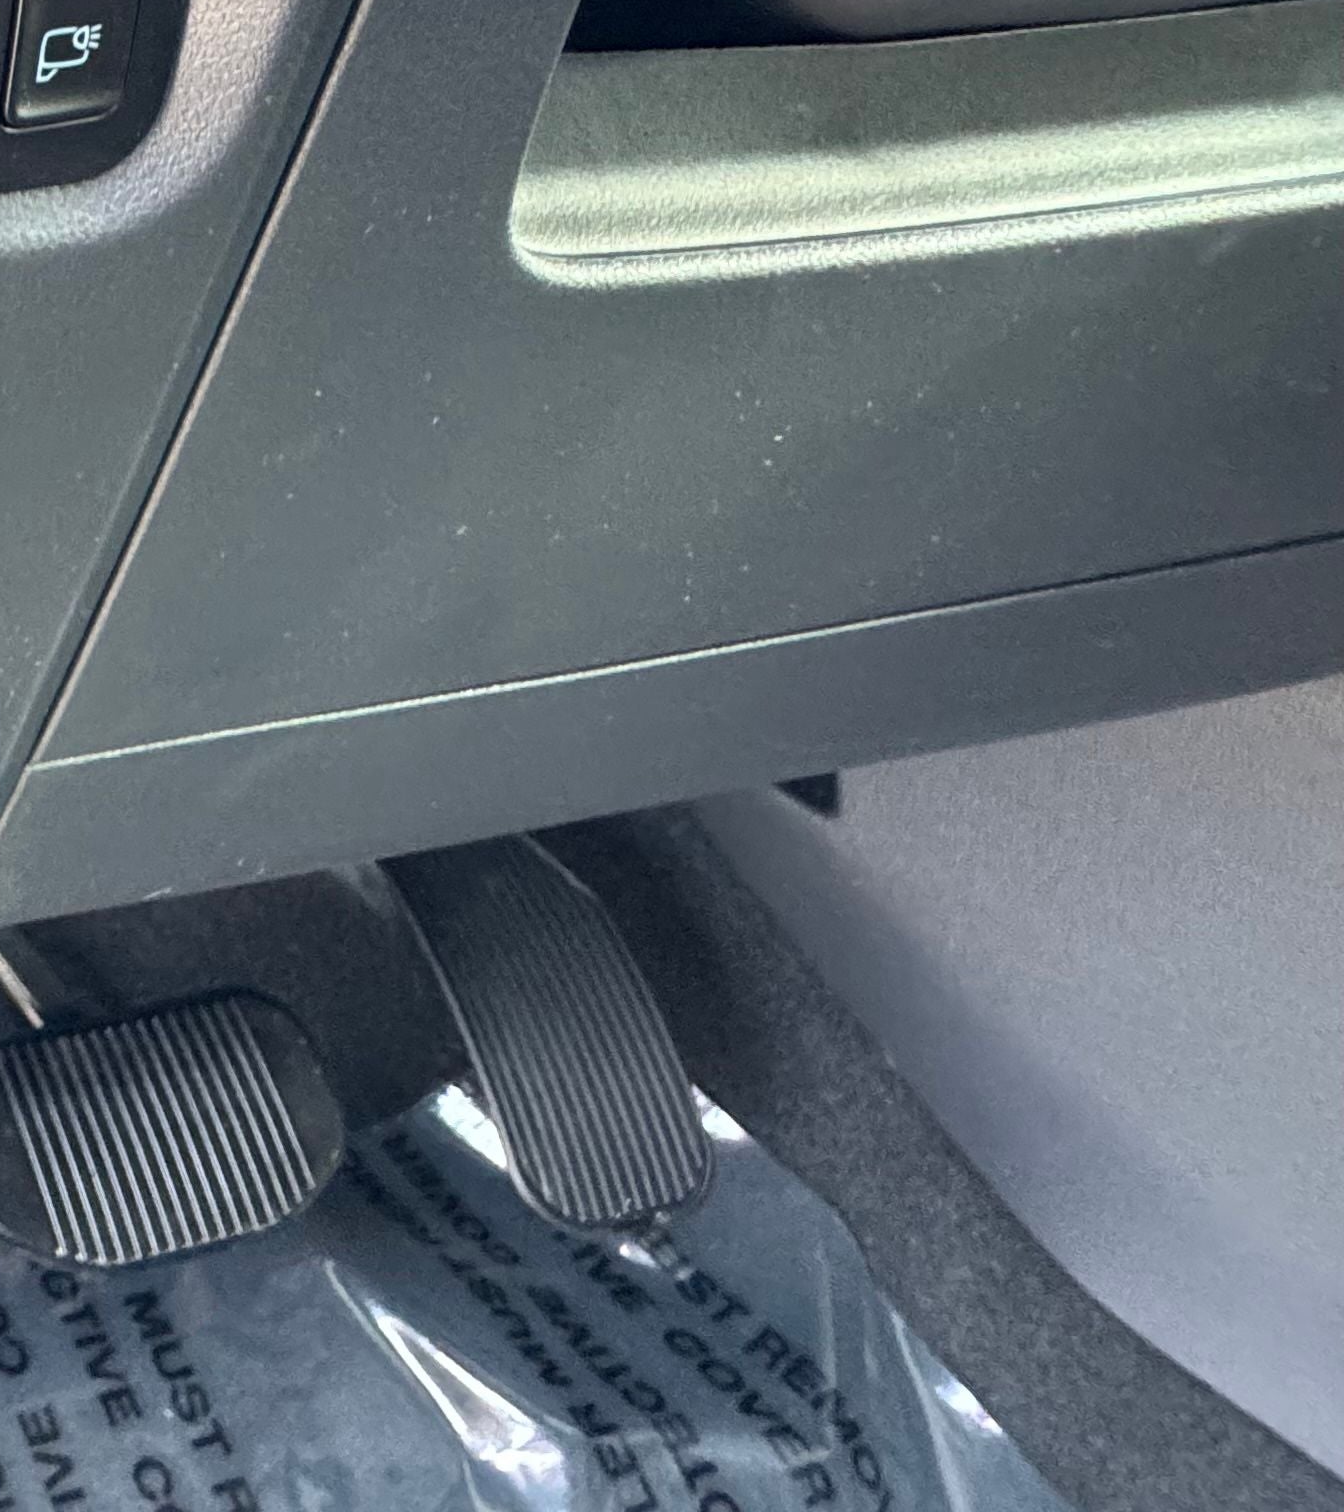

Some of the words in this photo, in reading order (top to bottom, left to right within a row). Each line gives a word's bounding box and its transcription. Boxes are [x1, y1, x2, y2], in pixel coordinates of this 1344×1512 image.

[29, 1260, 143, 1428] CTIVE
[123, 1290, 233, 1457] MUST
[663, 1325, 838, 1508] COVER
